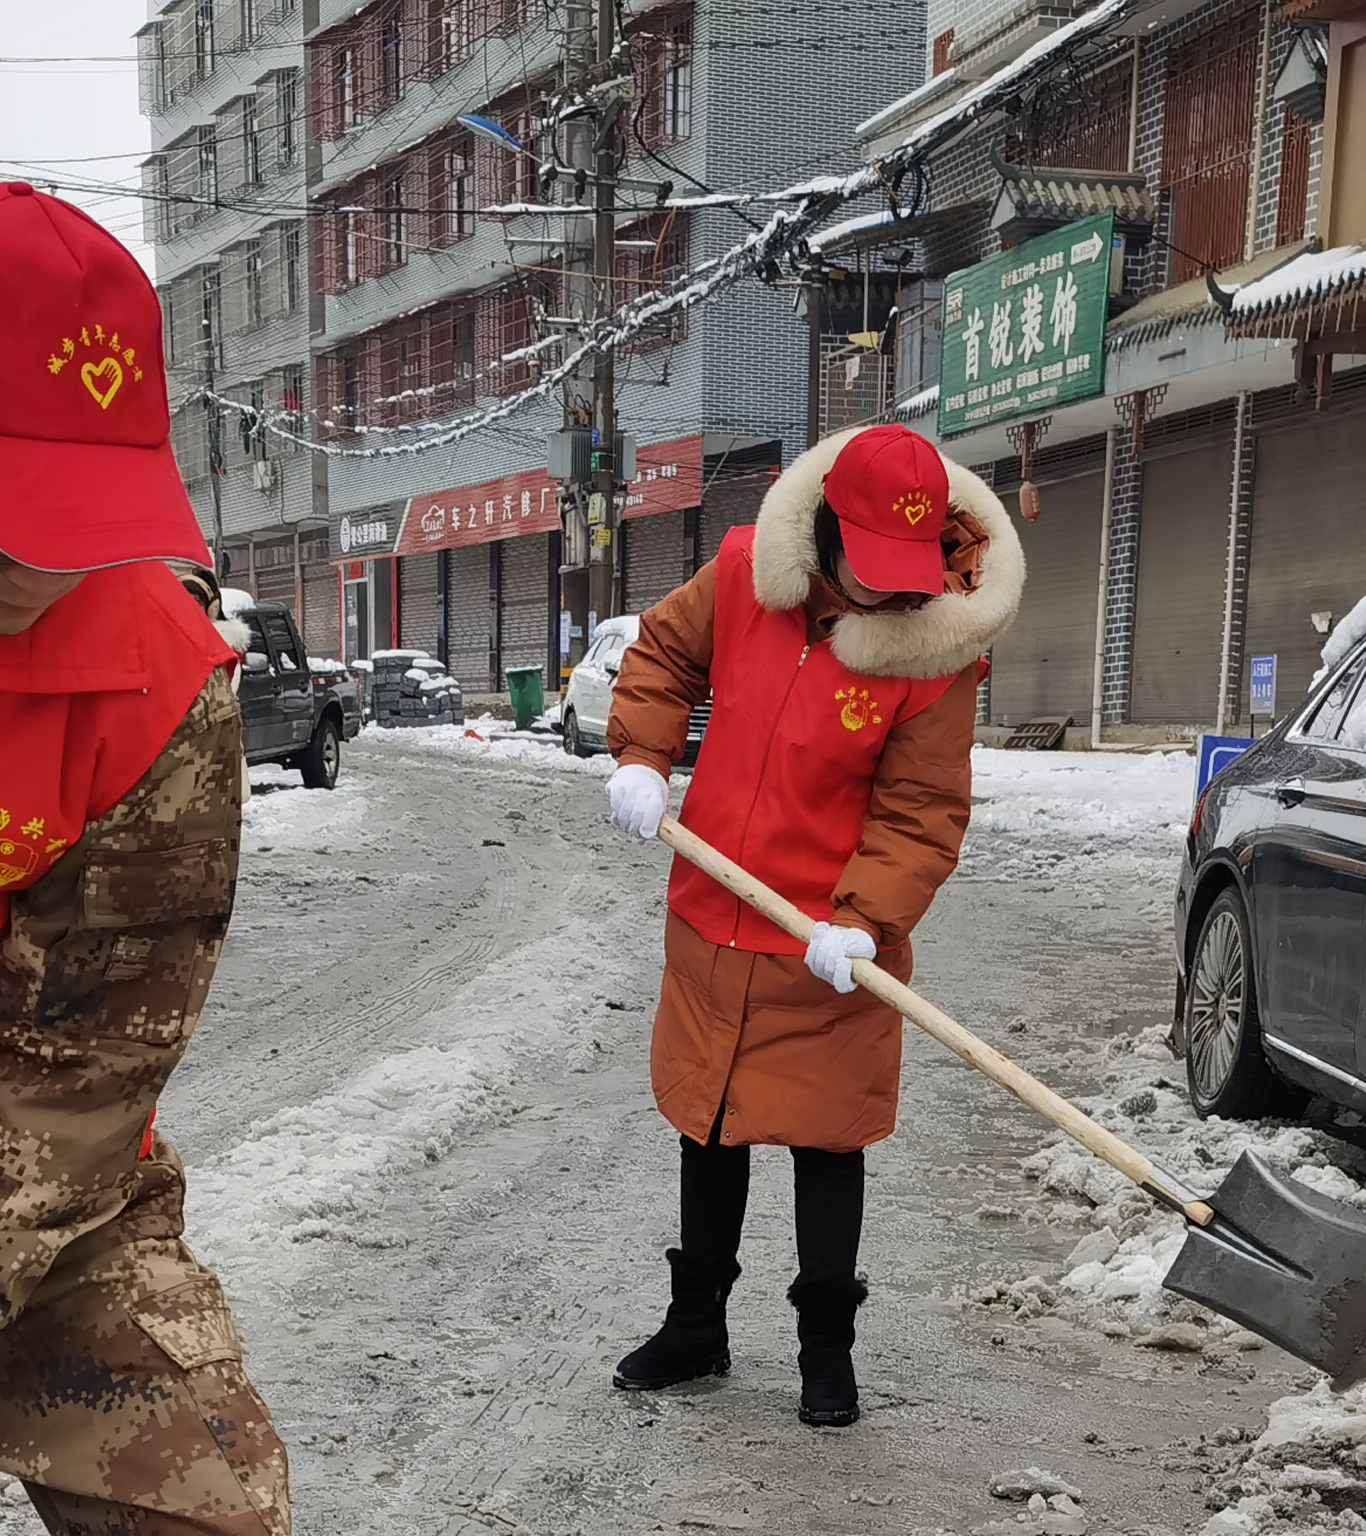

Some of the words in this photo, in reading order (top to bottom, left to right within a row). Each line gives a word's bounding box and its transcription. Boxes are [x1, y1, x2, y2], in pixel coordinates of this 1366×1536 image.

[961, 270, 1078, 382] 首锐装饰
[451, 487, 551, 532] 车之轩汽修厂
